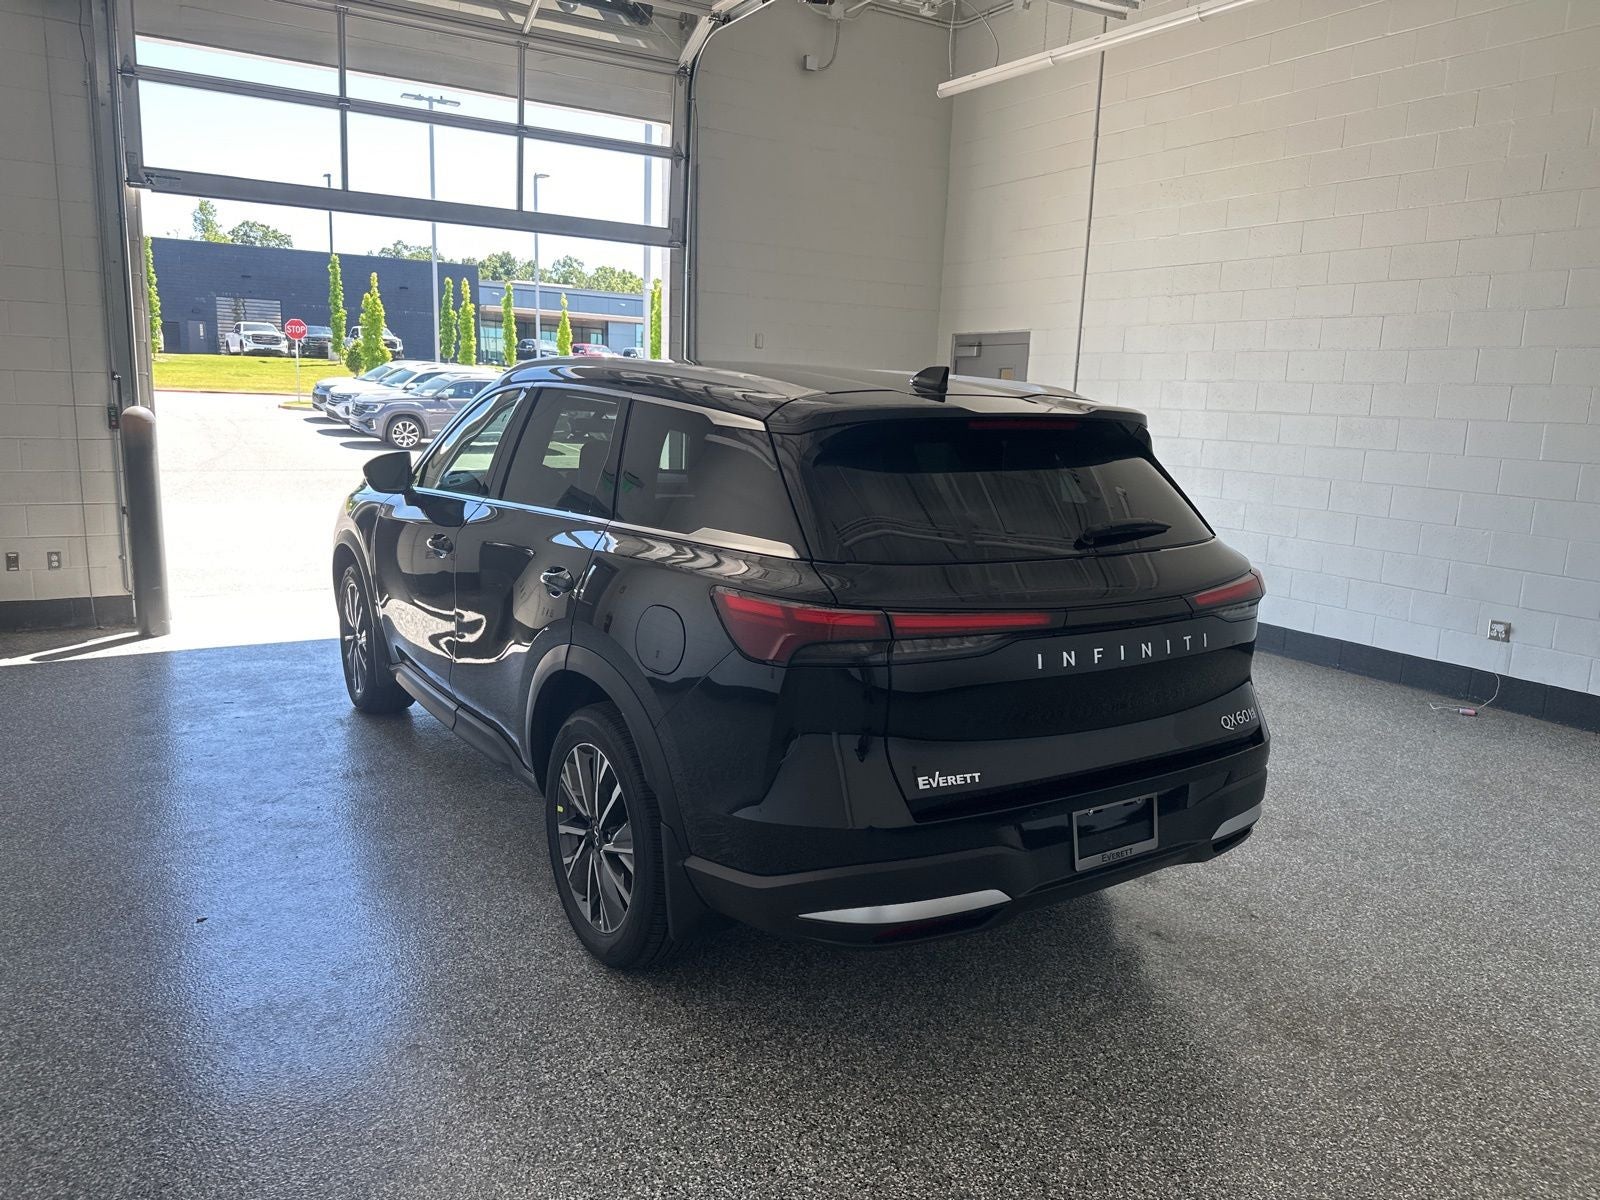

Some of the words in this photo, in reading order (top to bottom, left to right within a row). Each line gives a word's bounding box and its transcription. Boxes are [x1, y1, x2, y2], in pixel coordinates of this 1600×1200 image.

[286, 325, 305, 333] STOP
[1037, 632, 1208, 670] INFINITI
[917, 771, 981, 790] EVERETT
[1101, 847, 1134, 862] EVERETT
